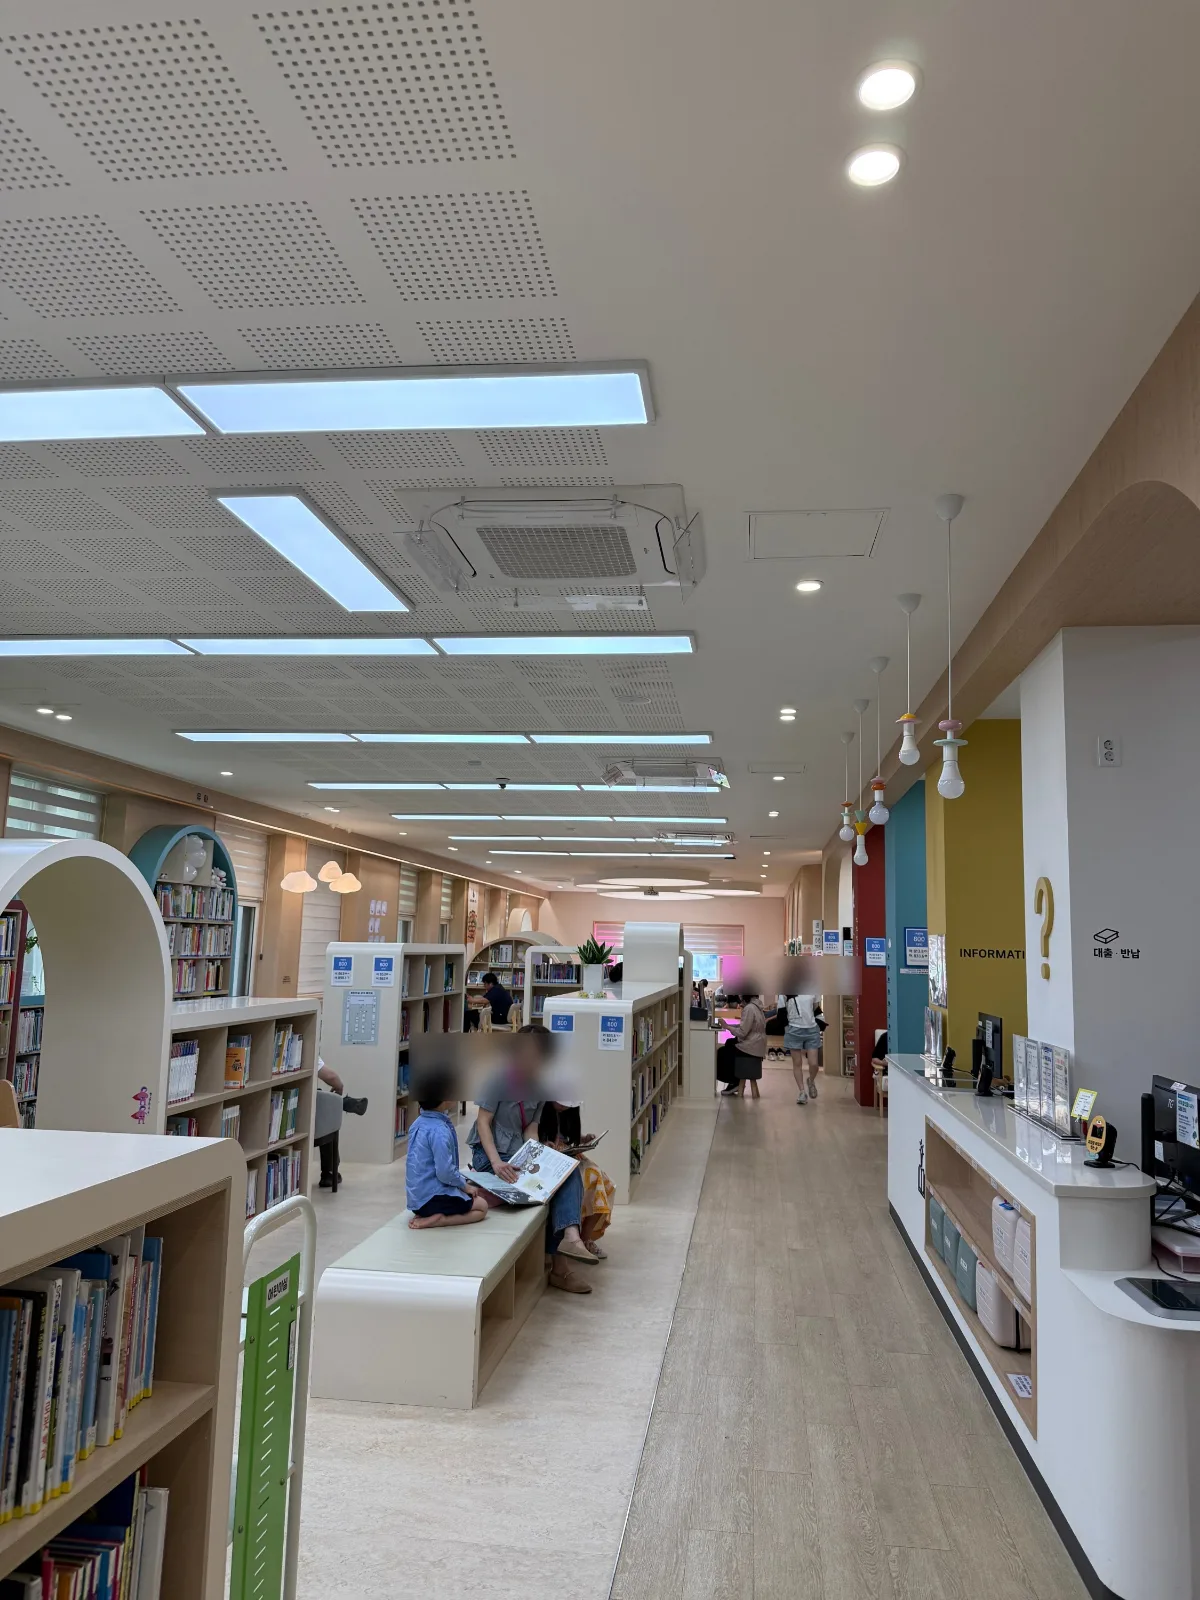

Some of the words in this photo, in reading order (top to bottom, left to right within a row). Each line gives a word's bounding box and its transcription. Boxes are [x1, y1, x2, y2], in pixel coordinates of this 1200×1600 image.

[1093, 947, 1114, 959] 대출
[1120, 947, 1141, 959] 반납
[268, 1277, 289, 1301] 어린이실
